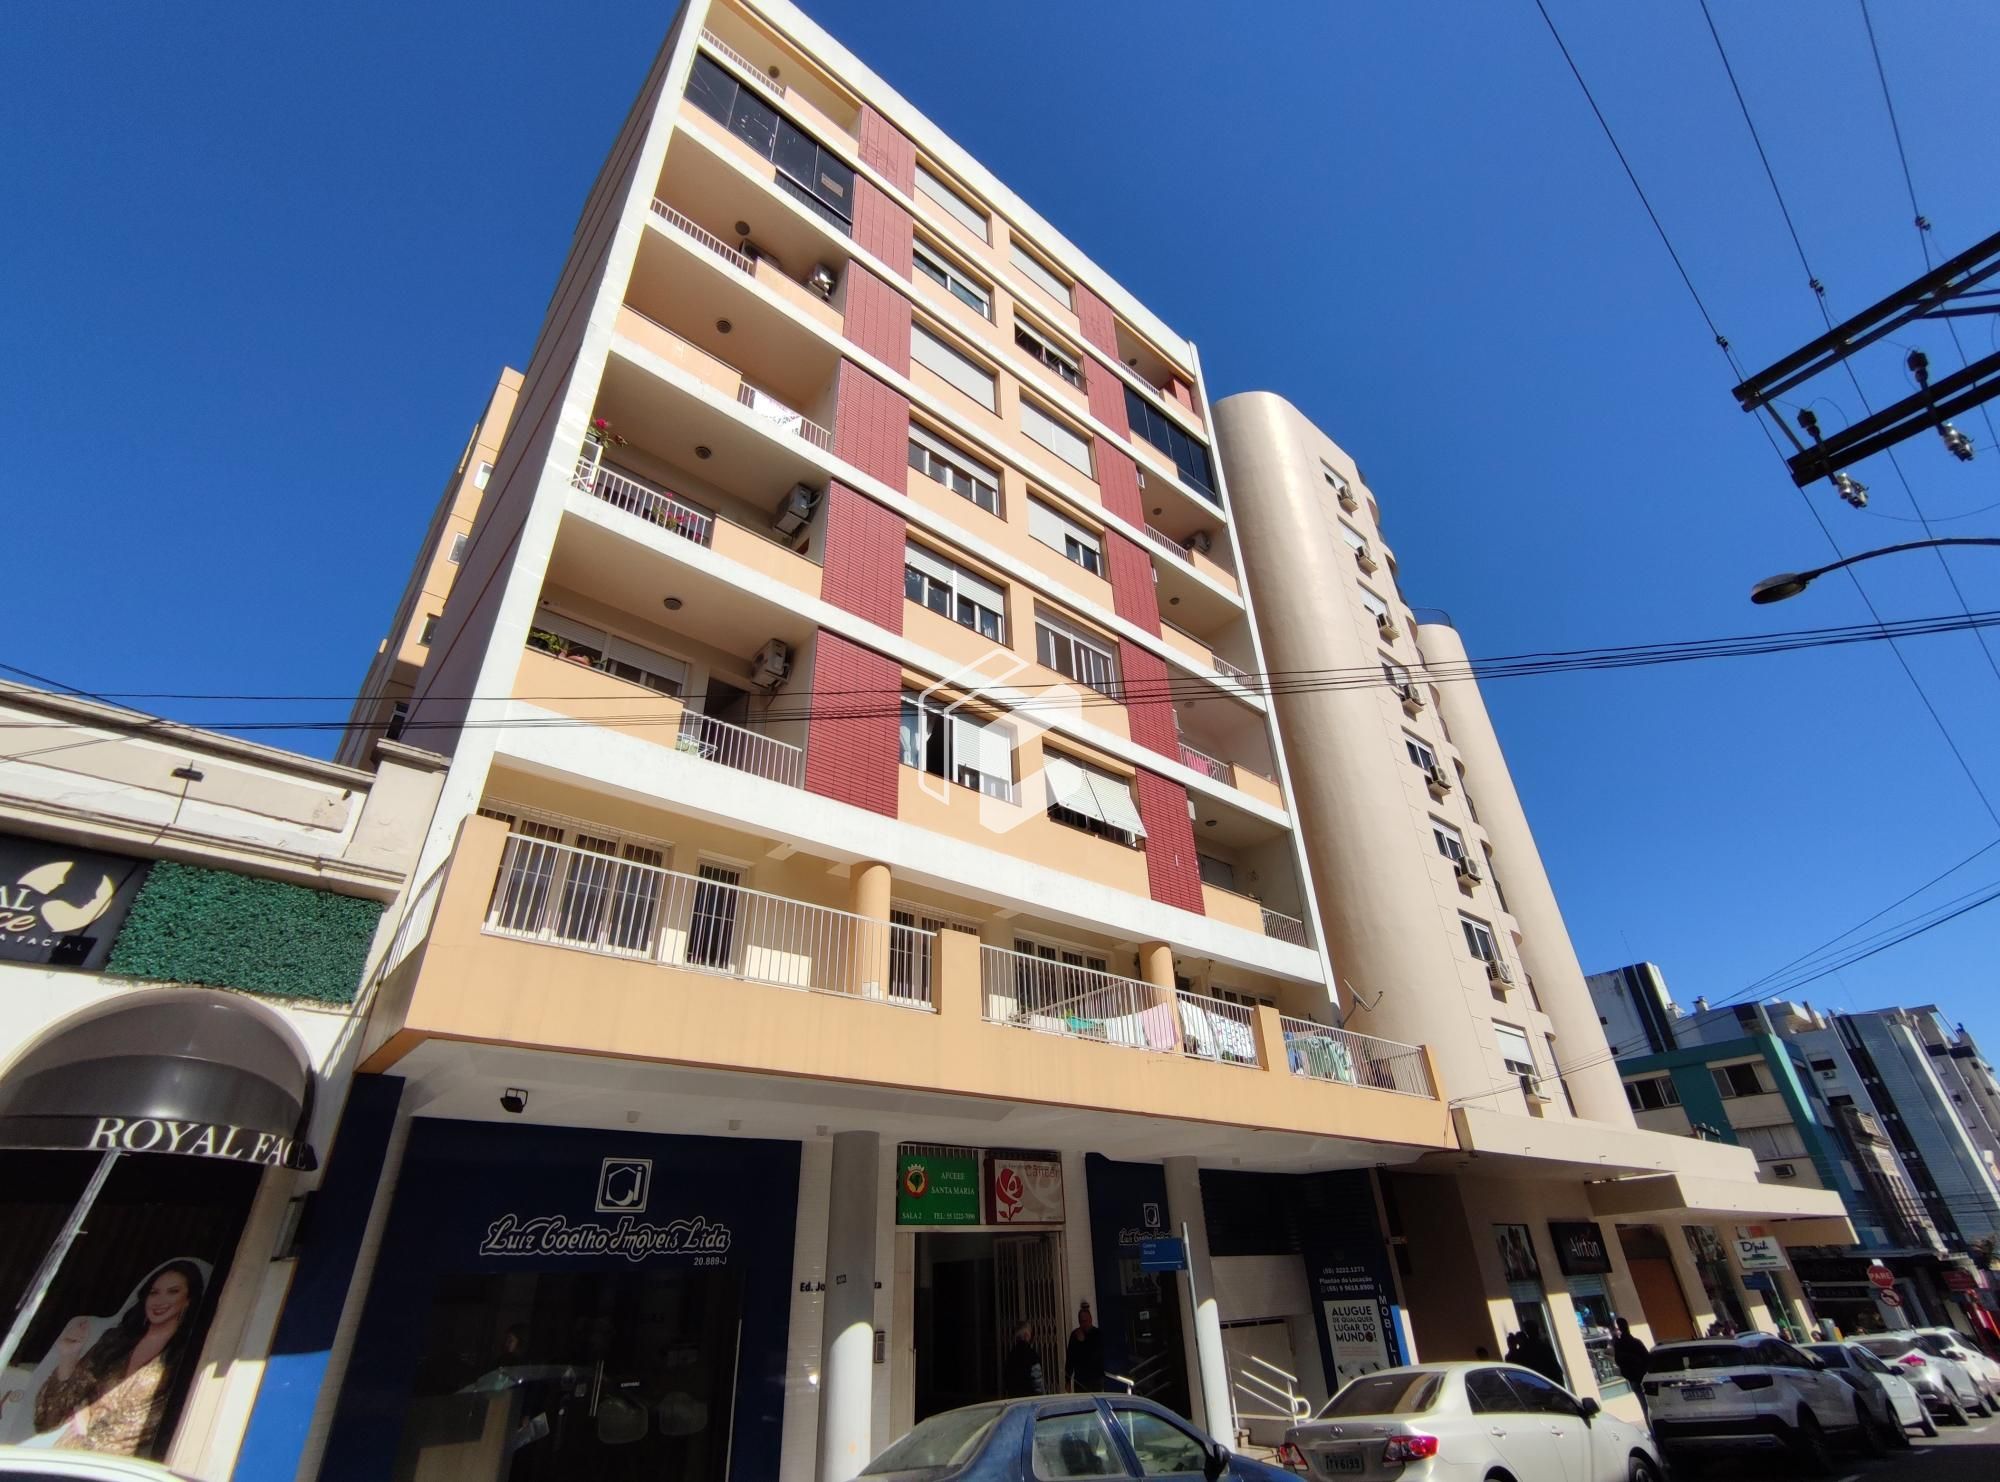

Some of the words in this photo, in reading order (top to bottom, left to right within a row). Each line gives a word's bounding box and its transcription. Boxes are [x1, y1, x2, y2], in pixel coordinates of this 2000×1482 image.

[86, 1117, 242, 1159] ROYAL
[931, 1186, 952, 1194] SANTA
[953, 1187, 975, 1195] MARIA
[486, 1219, 536, 1249] Luiz
[526, 1220, 607, 1249] Coelho
[1871, 1272, 1890, 1280] PARE
[800, 1281, 813, 1292] Ed.
[815, 1282, 825, 1291] Jo
[1332, 1306, 1372, 1316] ALUGUE
[1334, 1323, 1360, 1332] LUGAR
[1363, 1323, 1376, 1331] DO
